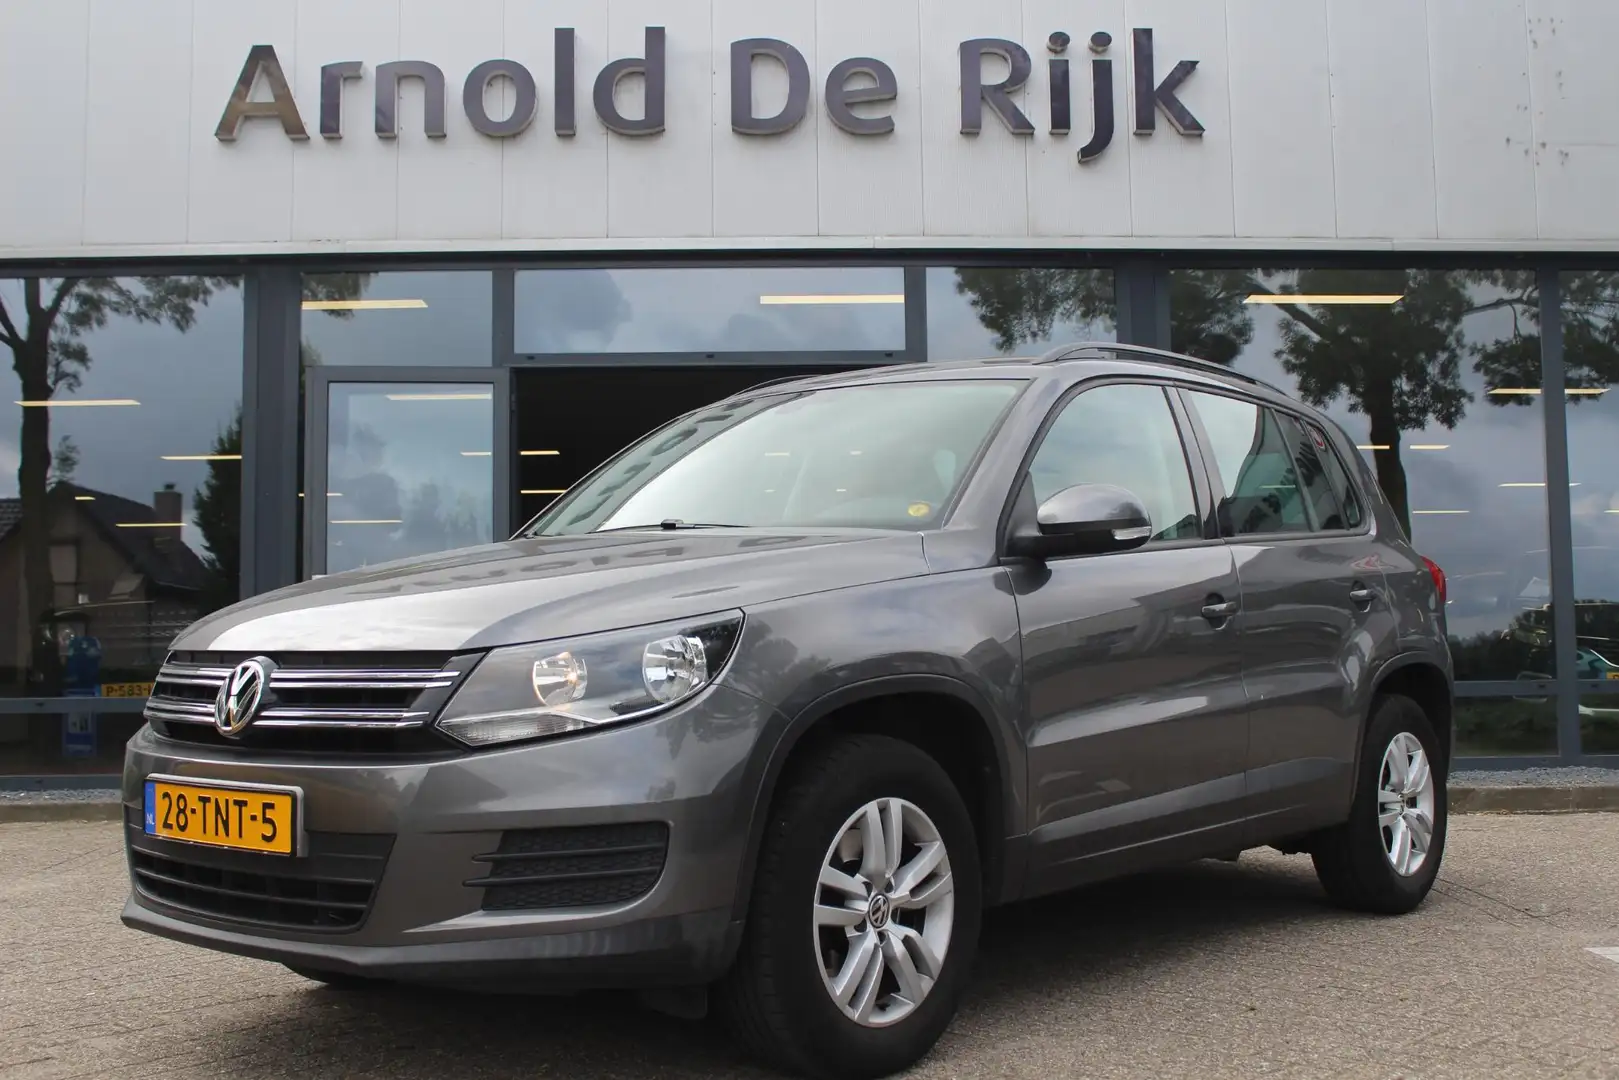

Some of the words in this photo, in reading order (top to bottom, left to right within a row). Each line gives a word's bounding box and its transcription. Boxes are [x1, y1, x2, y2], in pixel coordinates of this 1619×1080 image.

[214, 26, 666, 141] Arnold
[730, 37, 898, 135] De
[959, 27, 1206, 164] Rijk
[146, 812, 155, 826] NL
[161, 791, 278, 843] 28-TNT-5
